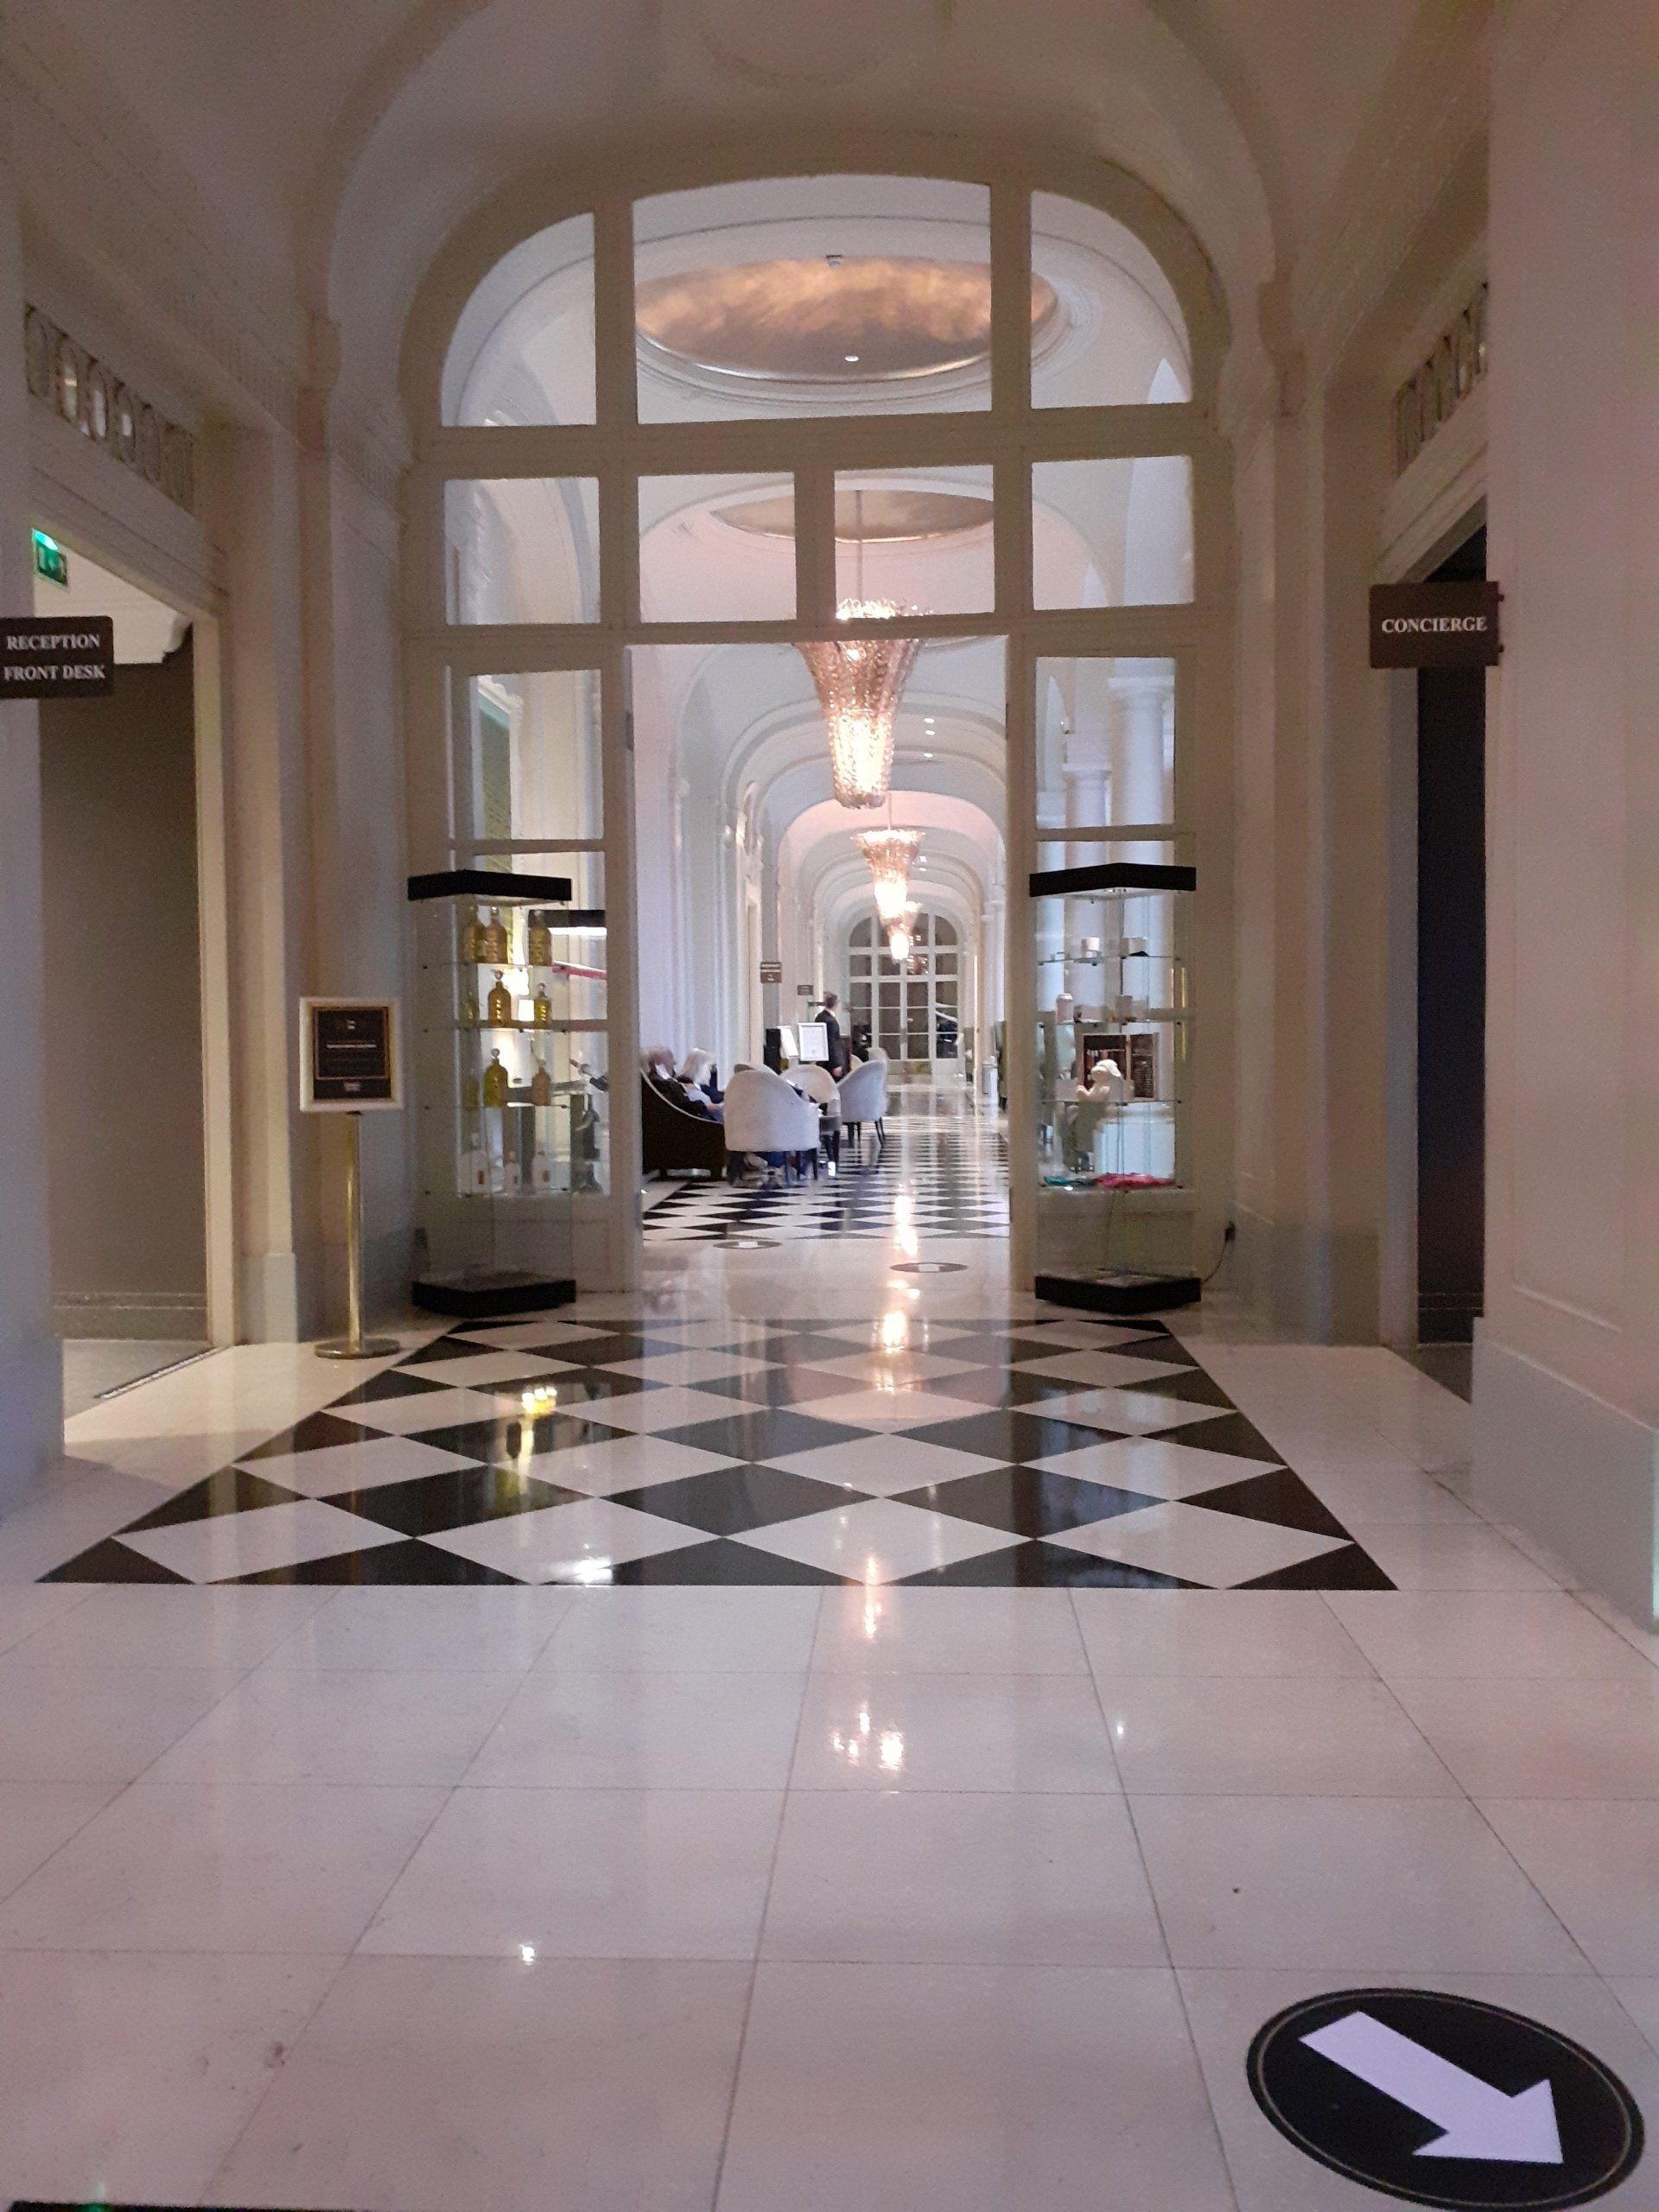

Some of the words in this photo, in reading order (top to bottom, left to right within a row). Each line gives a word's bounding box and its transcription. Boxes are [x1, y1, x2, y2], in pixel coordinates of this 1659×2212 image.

[1382, 617, 1488, 632] CONCIERGE
[7, 634, 100, 650] RECEPTION
[4, 665, 58, 681] FRONT
[63, 665, 105, 680] DESK
